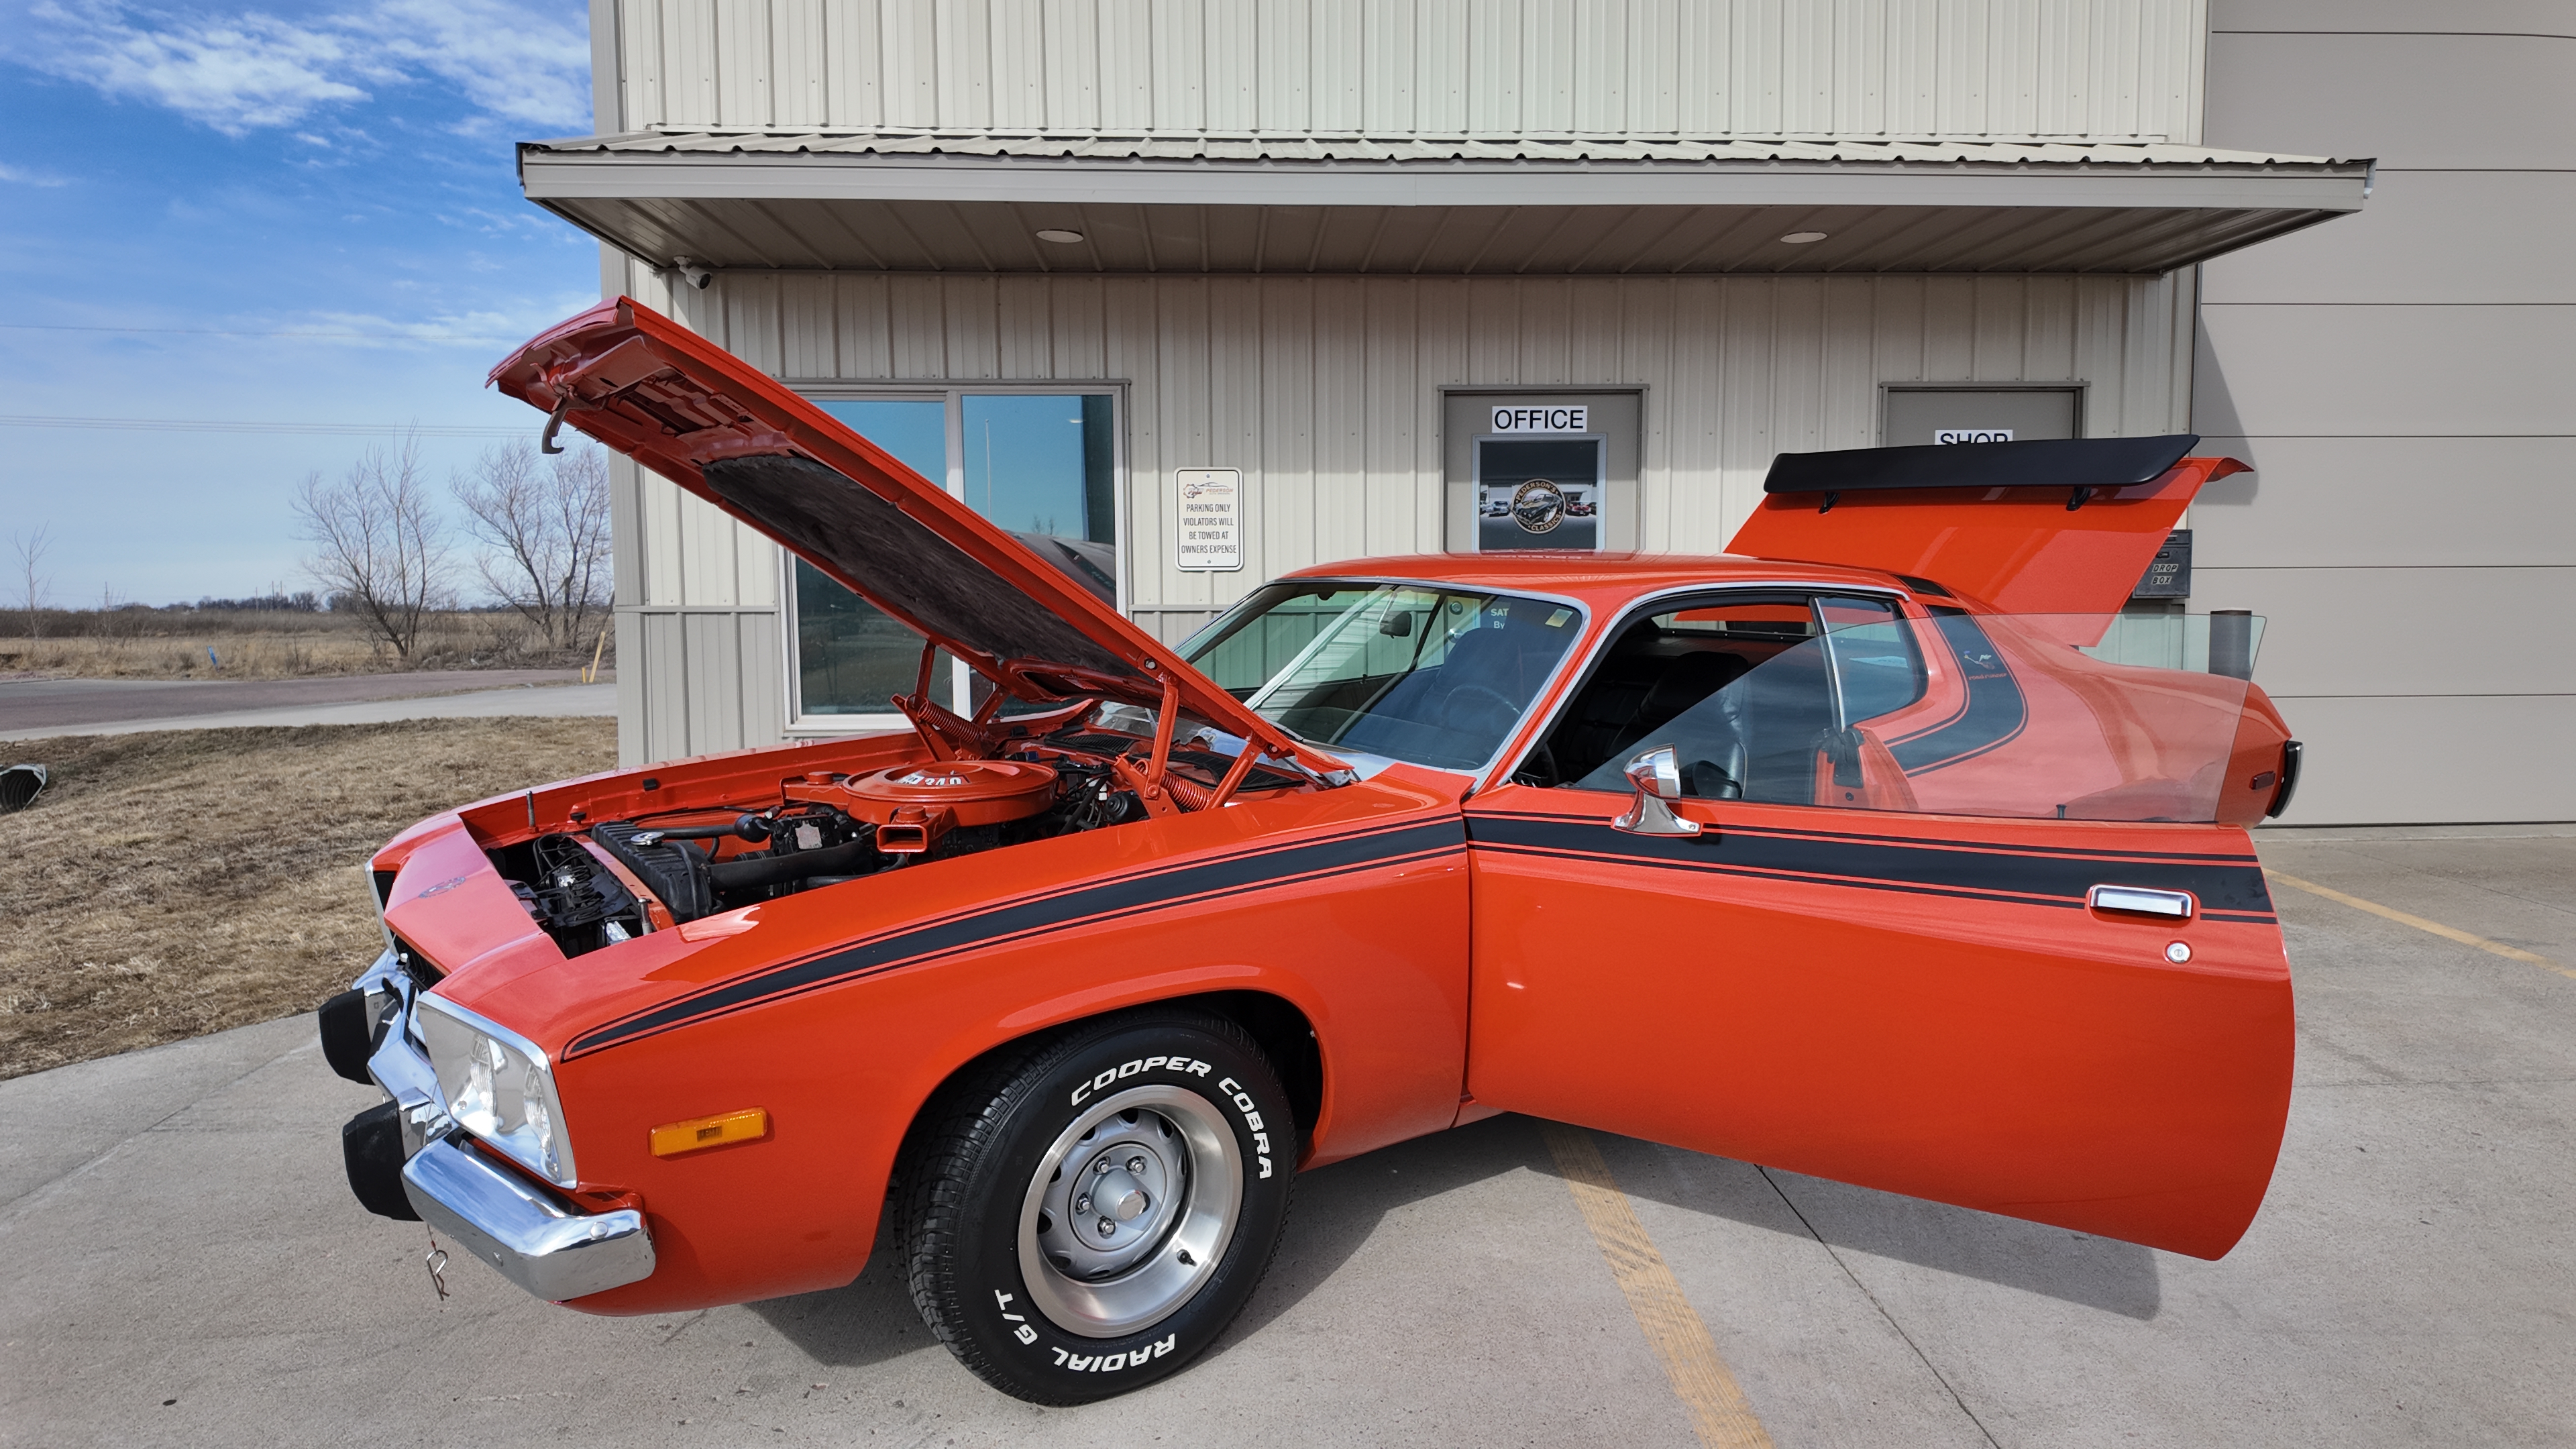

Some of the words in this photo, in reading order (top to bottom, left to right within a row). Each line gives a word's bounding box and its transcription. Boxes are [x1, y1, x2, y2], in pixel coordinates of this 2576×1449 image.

[1495, 409, 1584, 429] OFFICE
[1515, 481, 1556, 500] PEDERSON'S
[1186, 504, 1214, 513] PARKING
[1215, 504, 1231, 513] ONLY
[1183, 517, 1218, 526] VIOLATORS
[1218, 517, 1234, 526] WILL
[1531, 513, 1561, 531] CLASSICS
[1189, 531, 1197, 540] BE
[1197, 531, 1220, 540] TOWED
[1221, 531, 1229, 540] AT
[1181, 545, 1208, 553] OWNERS
[1210, 545, 1237, 553] EXPENSE
[2153, 564, 2178, 572] DROP
[2152, 576, 2171, 584] BOX
[1491, 608, 1509, 616] SAT
[1493, 621, 1505, 630] By
[1071, 1056, 1212, 1107] COOPER
[1218, 1077, 1273, 1180] COBRA
[994, 1289, 1038, 1346] G/T
[1051, 1333, 1175, 1373] RADIAL
